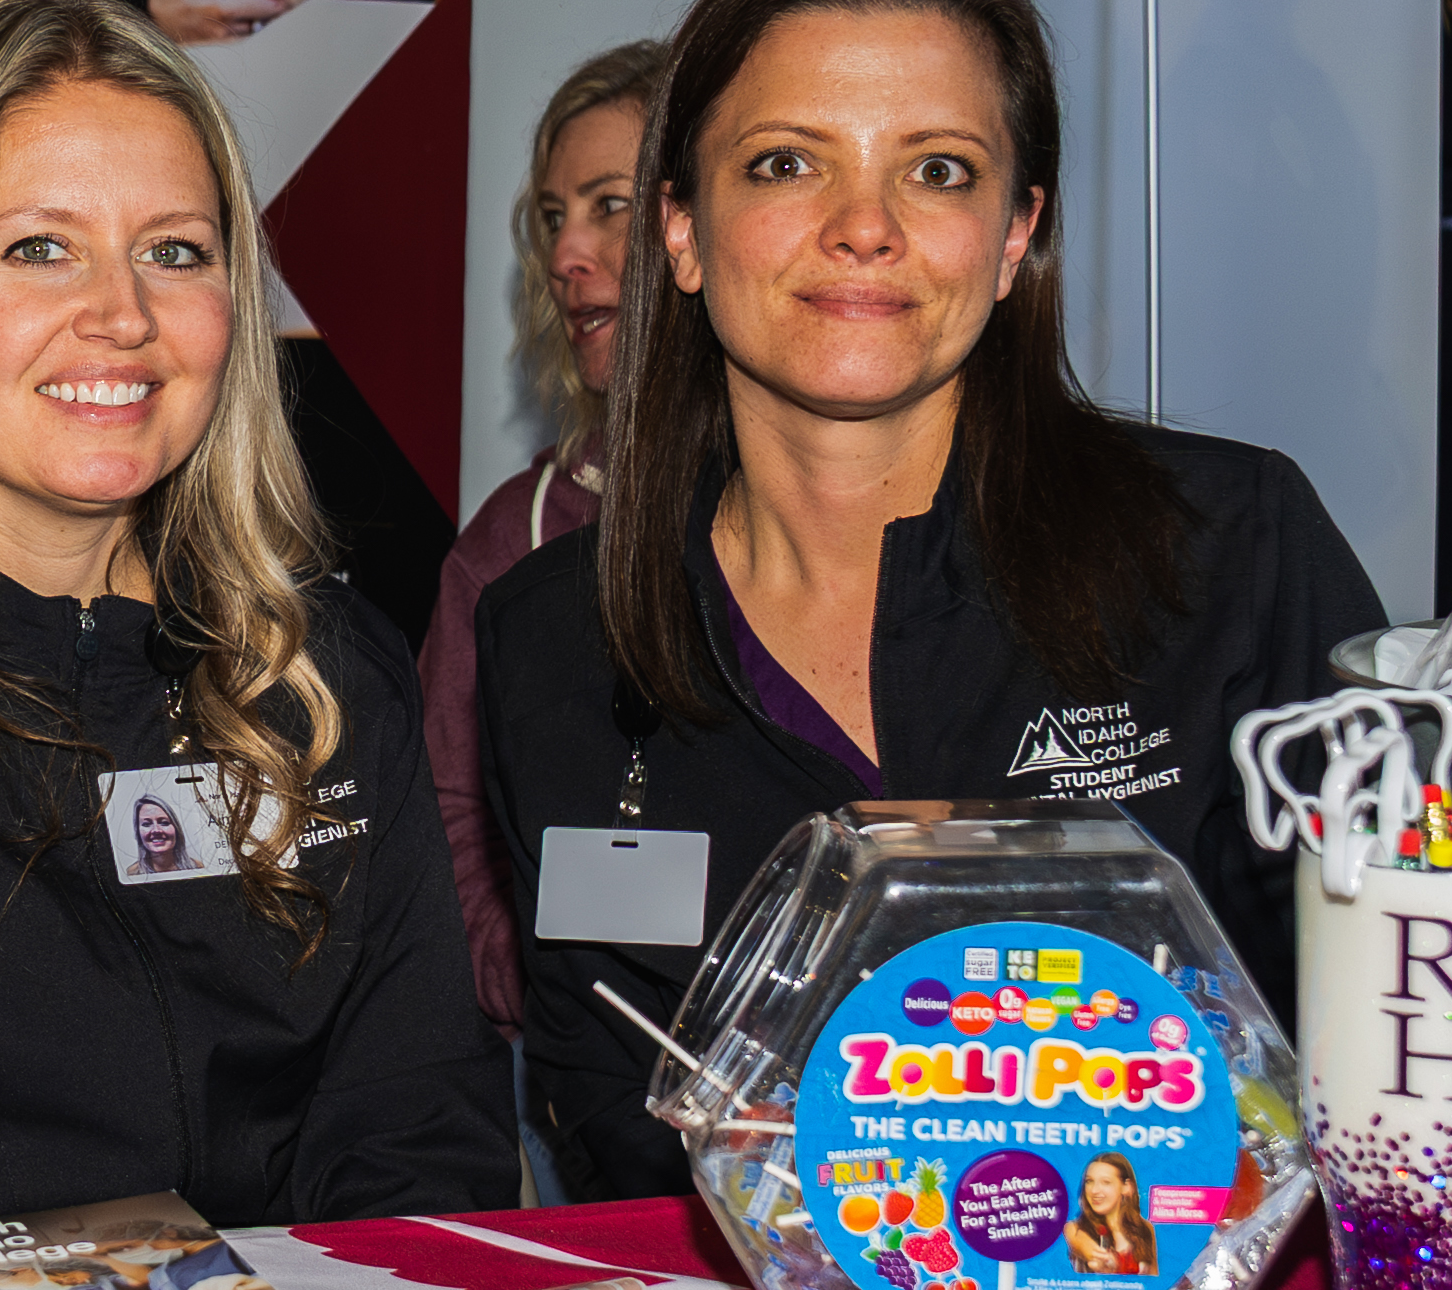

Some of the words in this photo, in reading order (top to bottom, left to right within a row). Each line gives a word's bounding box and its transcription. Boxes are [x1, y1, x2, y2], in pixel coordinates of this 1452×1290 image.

[1062, 702, 1130, 724] NORTH
[1079, 721, 1137, 744] IDAHO
[1091, 728, 1172, 764] COLLEGE
[1050, 764, 1137, 789] STUDENT
[298, 818, 369, 848] GIENIST
[965, 960, 995, 969] sugar
[965, 967, 994, 977] FREE
[904, 997, 949, 1010] Delicious
[999, 989, 1022, 1010] 0g
[1050, 995, 1078, 1006] VEGAN
[951, 1006, 994, 1020] KETO
[998, 1009, 1022, 1019] sugar
[1096, 1005, 1111, 1013] Free
[1118, 1003, 1132, 1012] Dye
[1073, 1011, 1096, 1019] Gluten
[1118, 1010, 1132, 1019] Free
[1076, 1018, 1091, 1027] Free
[1158, 1019, 1179, 1037] 0g
[850, 1117, 904, 1140] THE
[911, 1117, 1006, 1143] CLEAN
[1012, 1121, 1098, 1146] TEETH
[826, 1147, 889, 1160] DELICIOUS
[817, 1158, 905, 1186] FRUIT
[833, 1182, 888, 1195] FLAVORS
[970, 1182, 997, 1196] The
[1001, 1176, 1038, 1193] After
[959, 1197, 987, 1212] You
[991, 1194, 1014, 1209] Eat
[1017, 1189, 1052, 1205] Treat
[1160, 1198, 1192, 1206] Inventor
[960, 1214, 985, 1228] For
[988, 1214, 997, 1225] a
[999, 1204, 1057, 1226] Healthy
[1153, 1208, 1175, 1217] Alina
[1176, 1209, 1204, 1218] Morse
[987, 1222, 1034, 1240] Smile!
